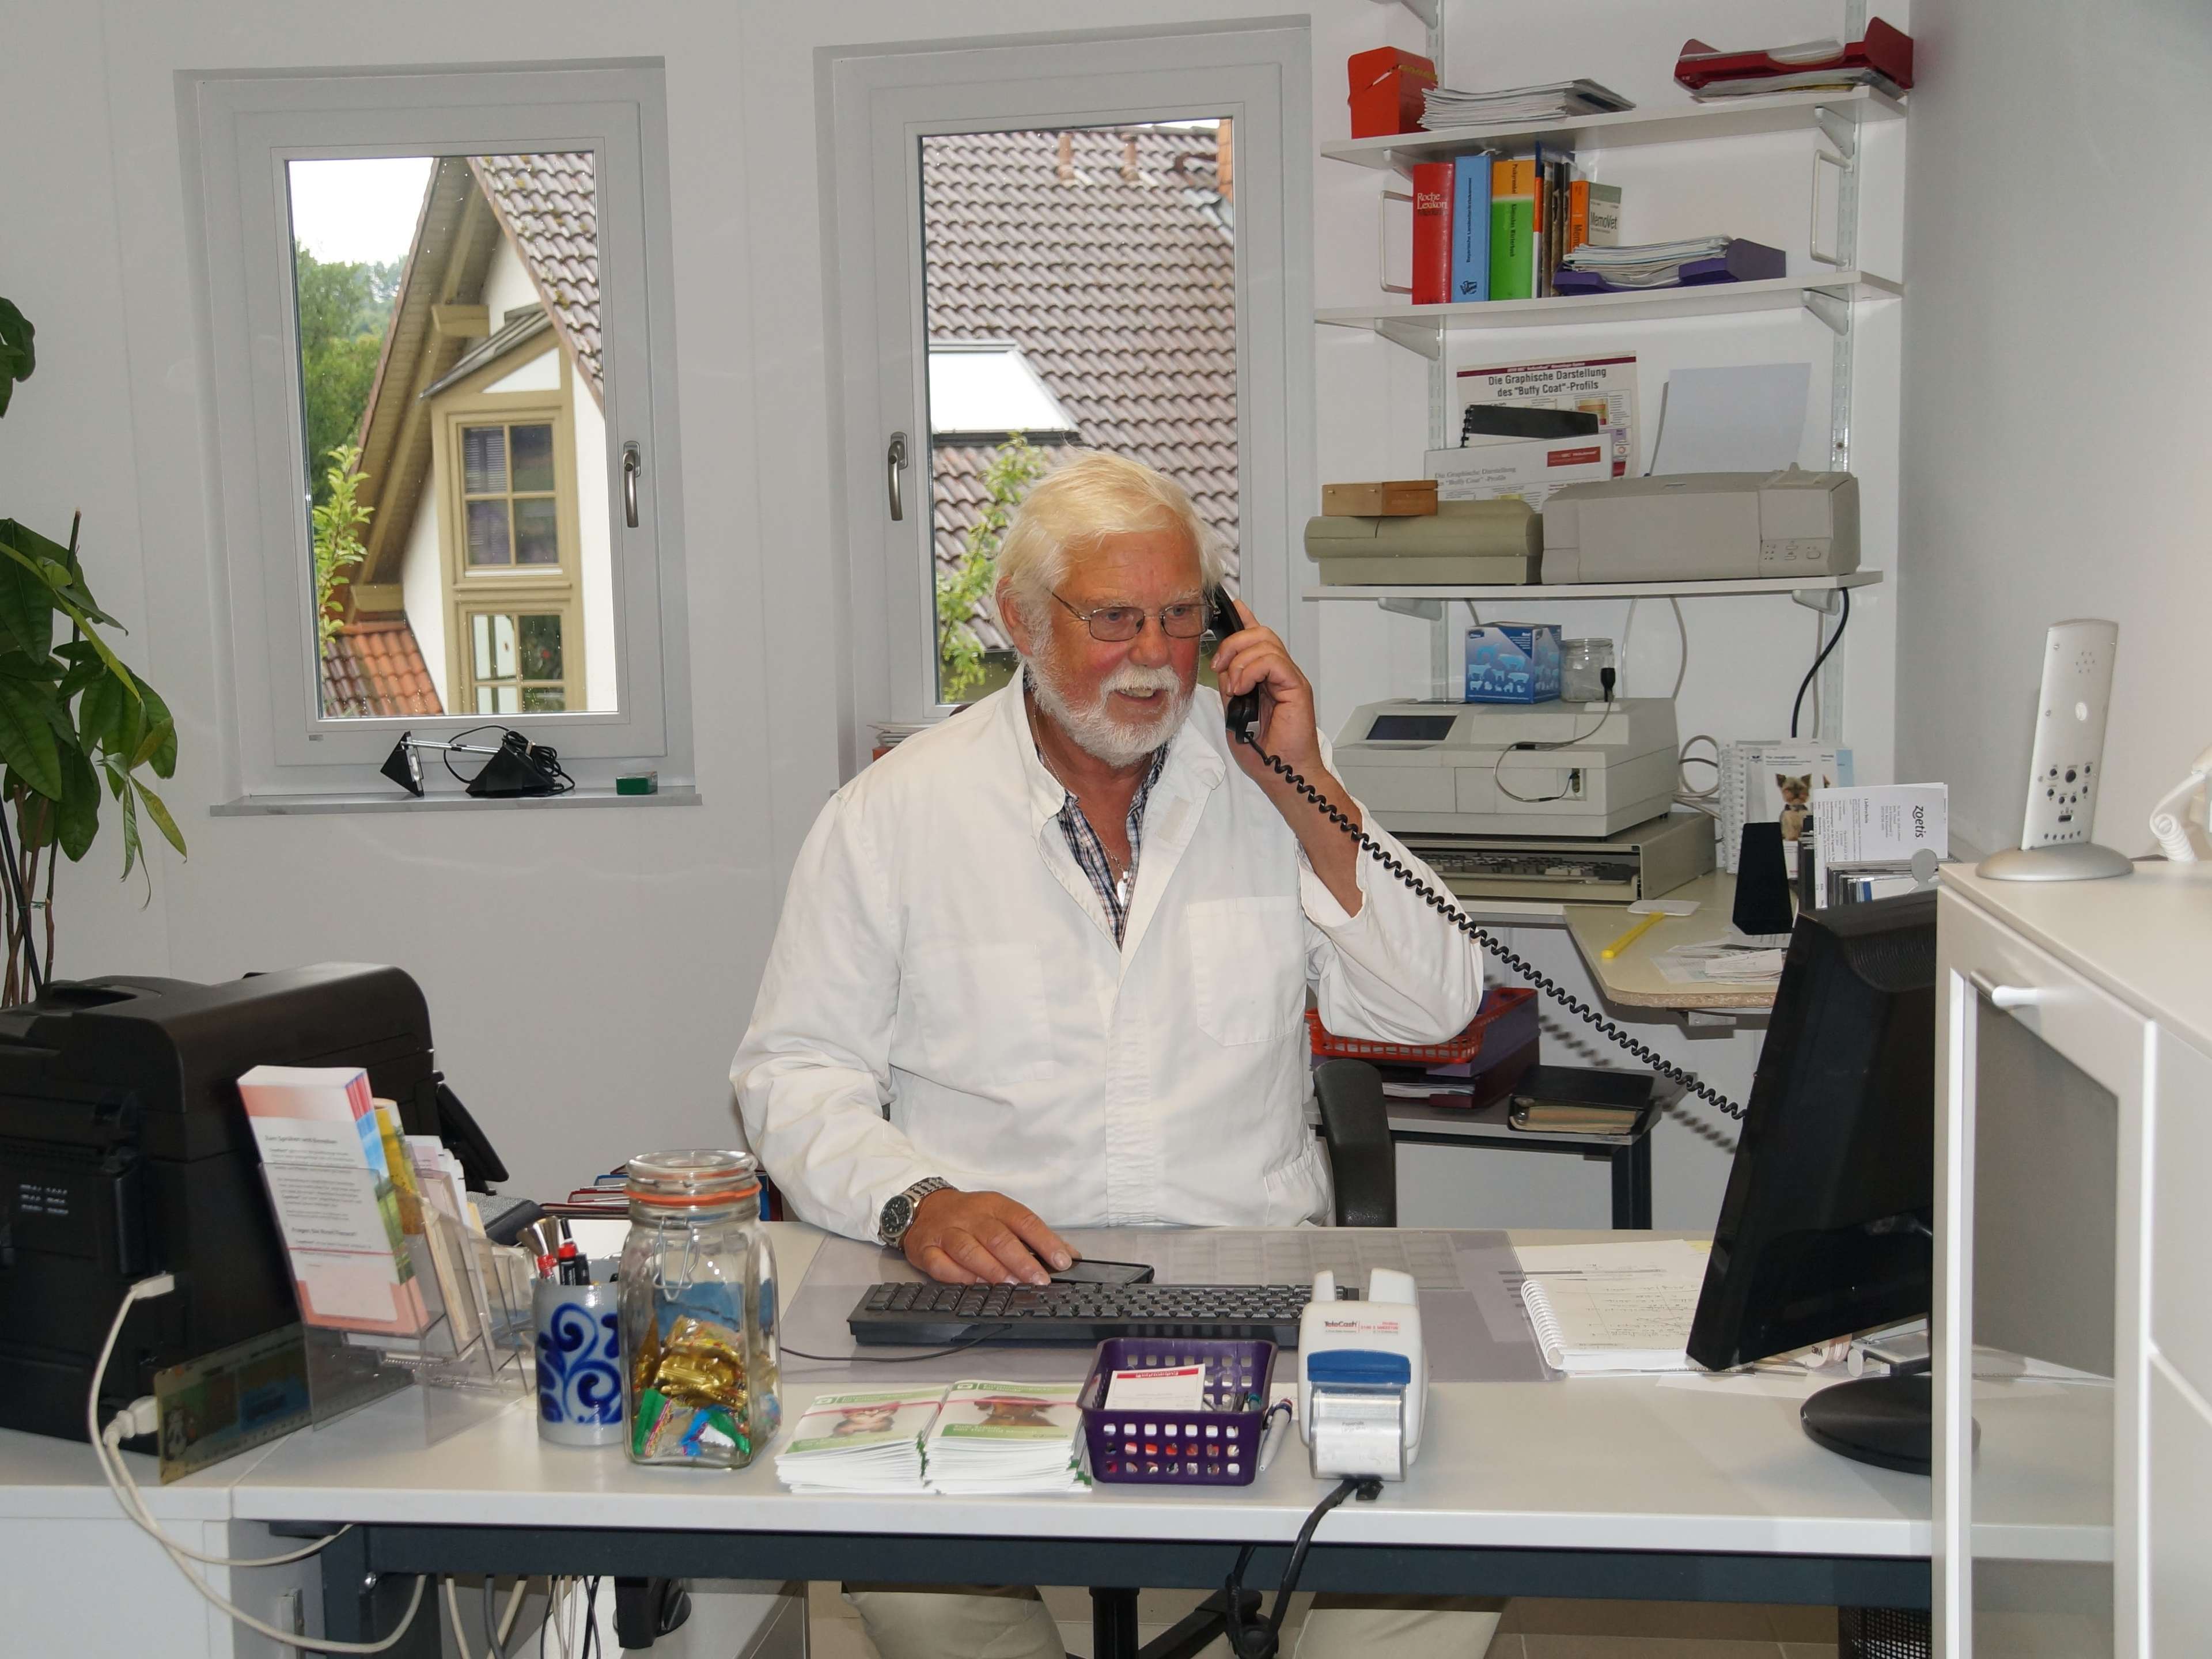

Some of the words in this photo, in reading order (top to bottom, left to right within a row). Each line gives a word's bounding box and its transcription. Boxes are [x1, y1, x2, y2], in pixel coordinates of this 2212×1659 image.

[1417, 192, 1441, 201] Roche
[1417, 200, 1447, 209] Lexikon
[1488, 376, 1502, 385] Die
[1505, 372, 1554, 385] Graphische
[1556, 368, 1607, 381] Darstellung
[1498, 387, 1513, 397] des
[1514, 384, 1540, 396] "Buffy
[1912, 805, 1926, 838] zoetis
[1812, 1346, 1823, 1357] 3M
